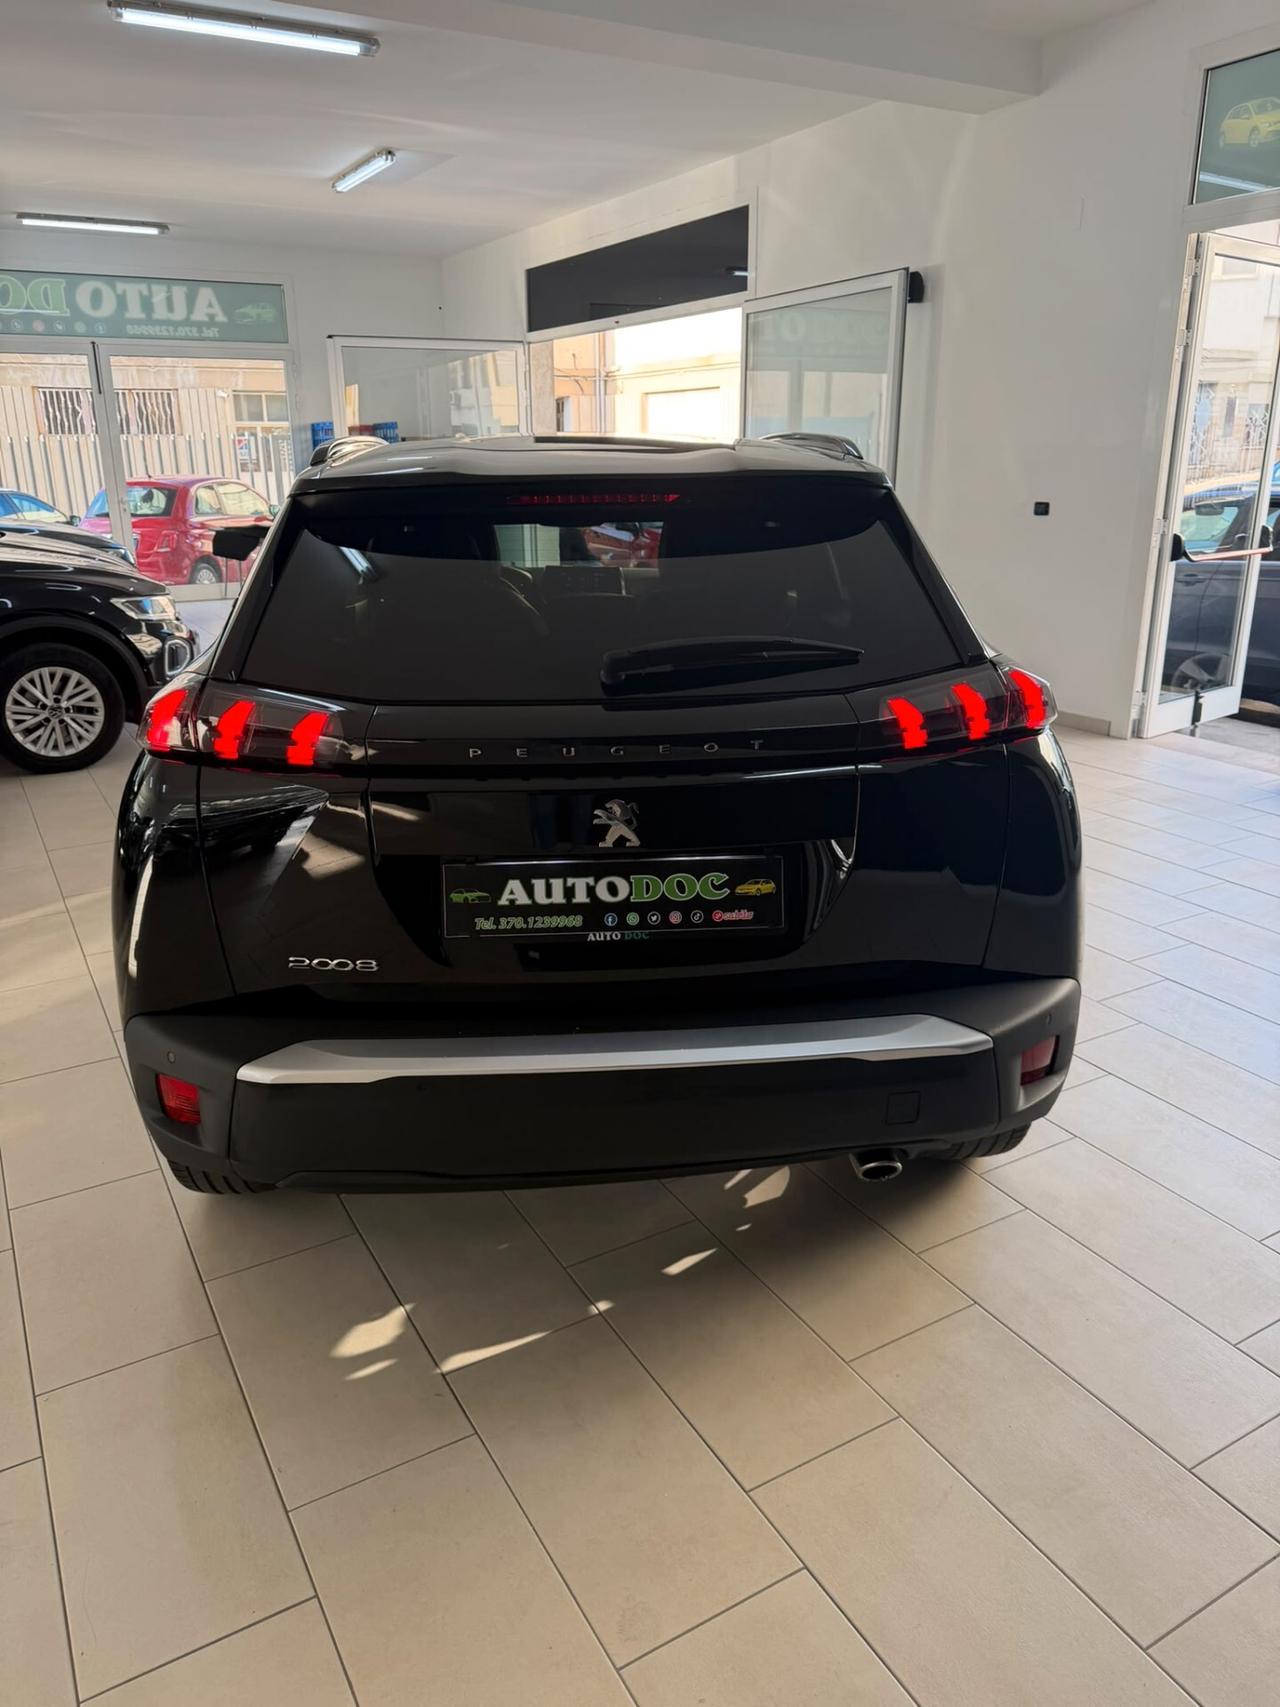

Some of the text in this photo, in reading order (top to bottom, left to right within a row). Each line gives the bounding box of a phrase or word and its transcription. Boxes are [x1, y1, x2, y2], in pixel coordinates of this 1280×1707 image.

[469, 739, 764, 759] PEUGEOT
[474, 914, 584, 931] Tel. 370.1239968
[587, 931, 621, 942] AUTO
[288, 956, 379, 972] 2008
